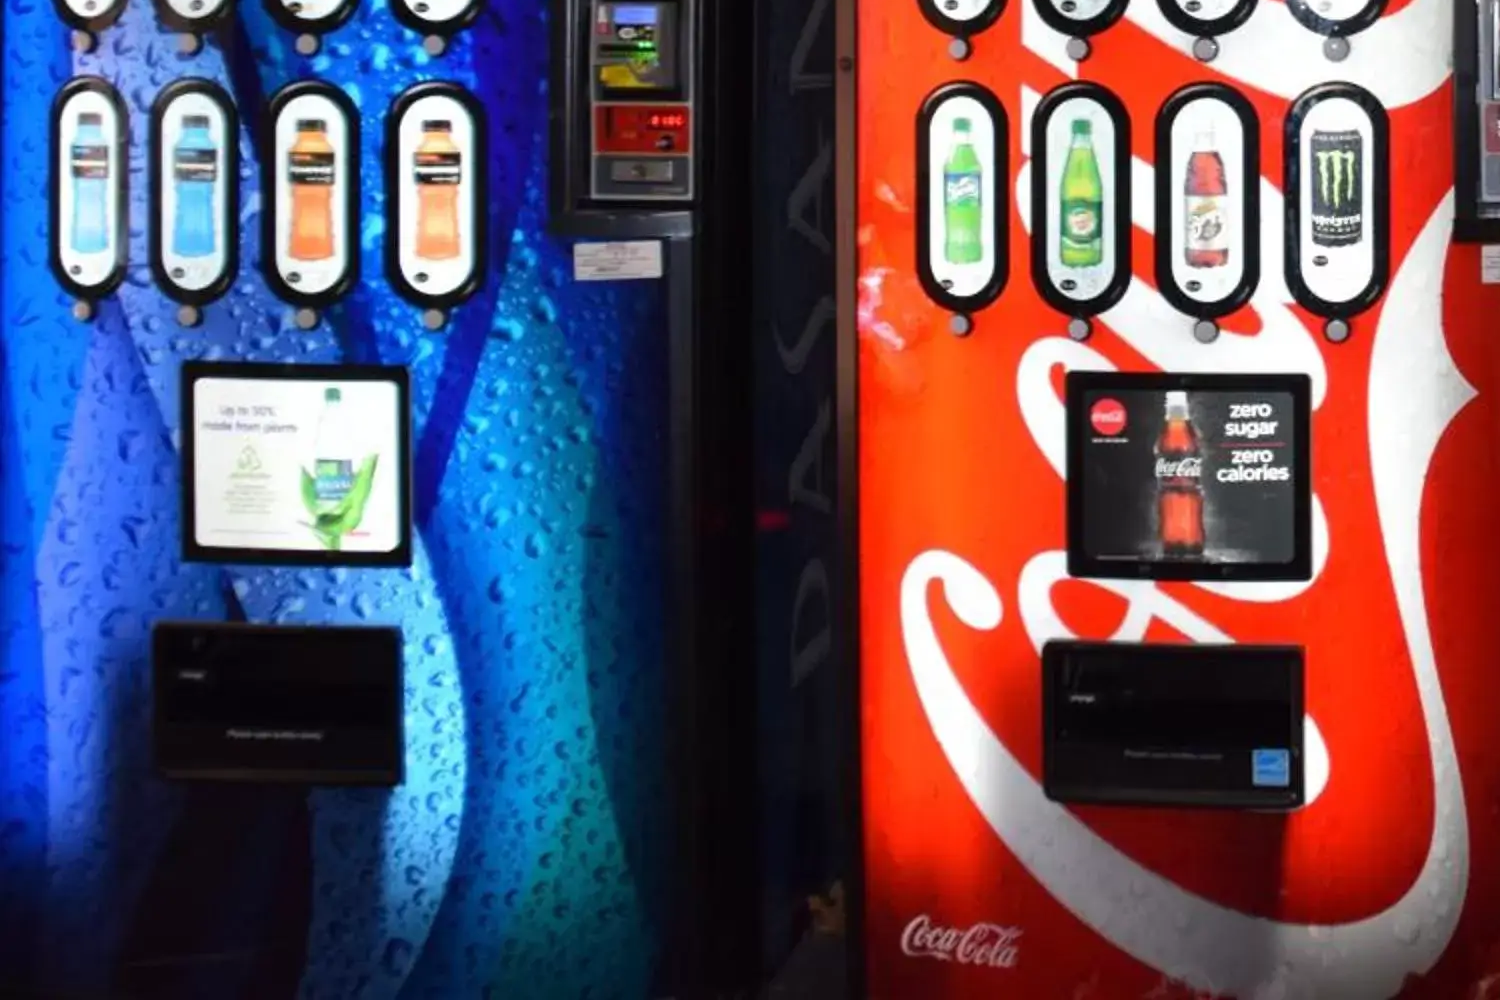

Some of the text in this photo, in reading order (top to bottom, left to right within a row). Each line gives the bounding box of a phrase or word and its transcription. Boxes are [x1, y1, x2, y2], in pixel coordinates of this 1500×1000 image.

[1229, 403, 1272, 418] zero
[1224, 420, 1279, 438] sugar
[1231, 449, 1274, 464] zero
[1216, 464, 1290, 483] calories
[901, 914, 1024, 968] Coca-Cola
